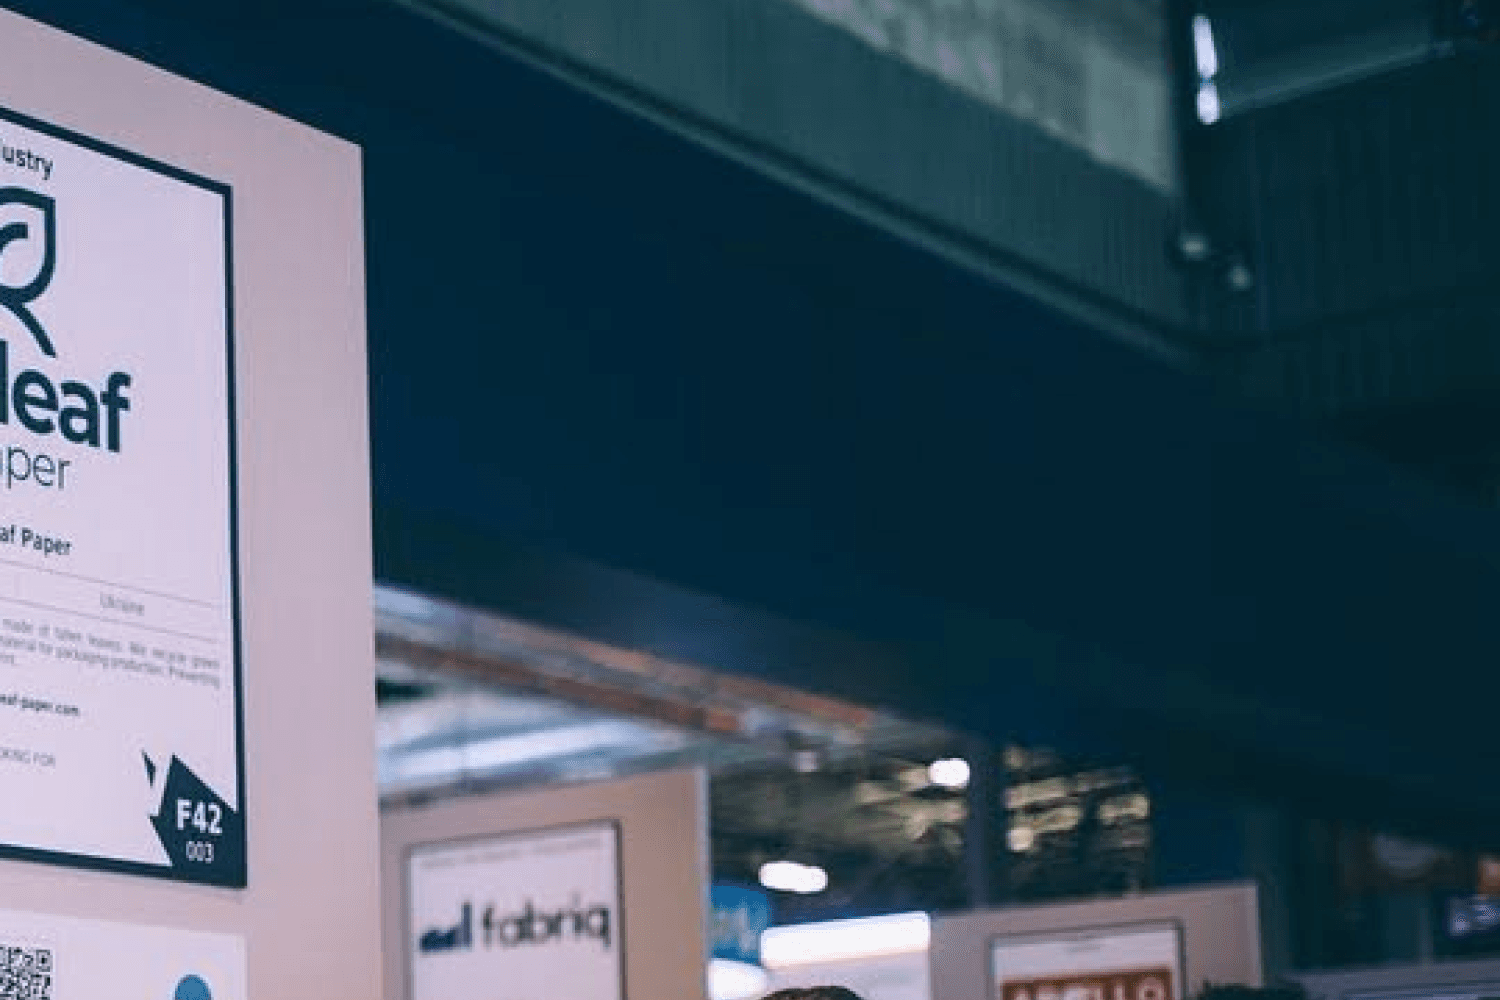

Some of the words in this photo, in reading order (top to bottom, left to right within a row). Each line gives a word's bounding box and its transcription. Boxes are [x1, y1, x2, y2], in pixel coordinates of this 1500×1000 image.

[21, 527, 73, 557] Paper
[100, 592, 145, 617] Ukraine
[177, 799, 223, 835] F42
[185, 840, 215, 863] 003
[483, 892, 612, 949] fabriq
